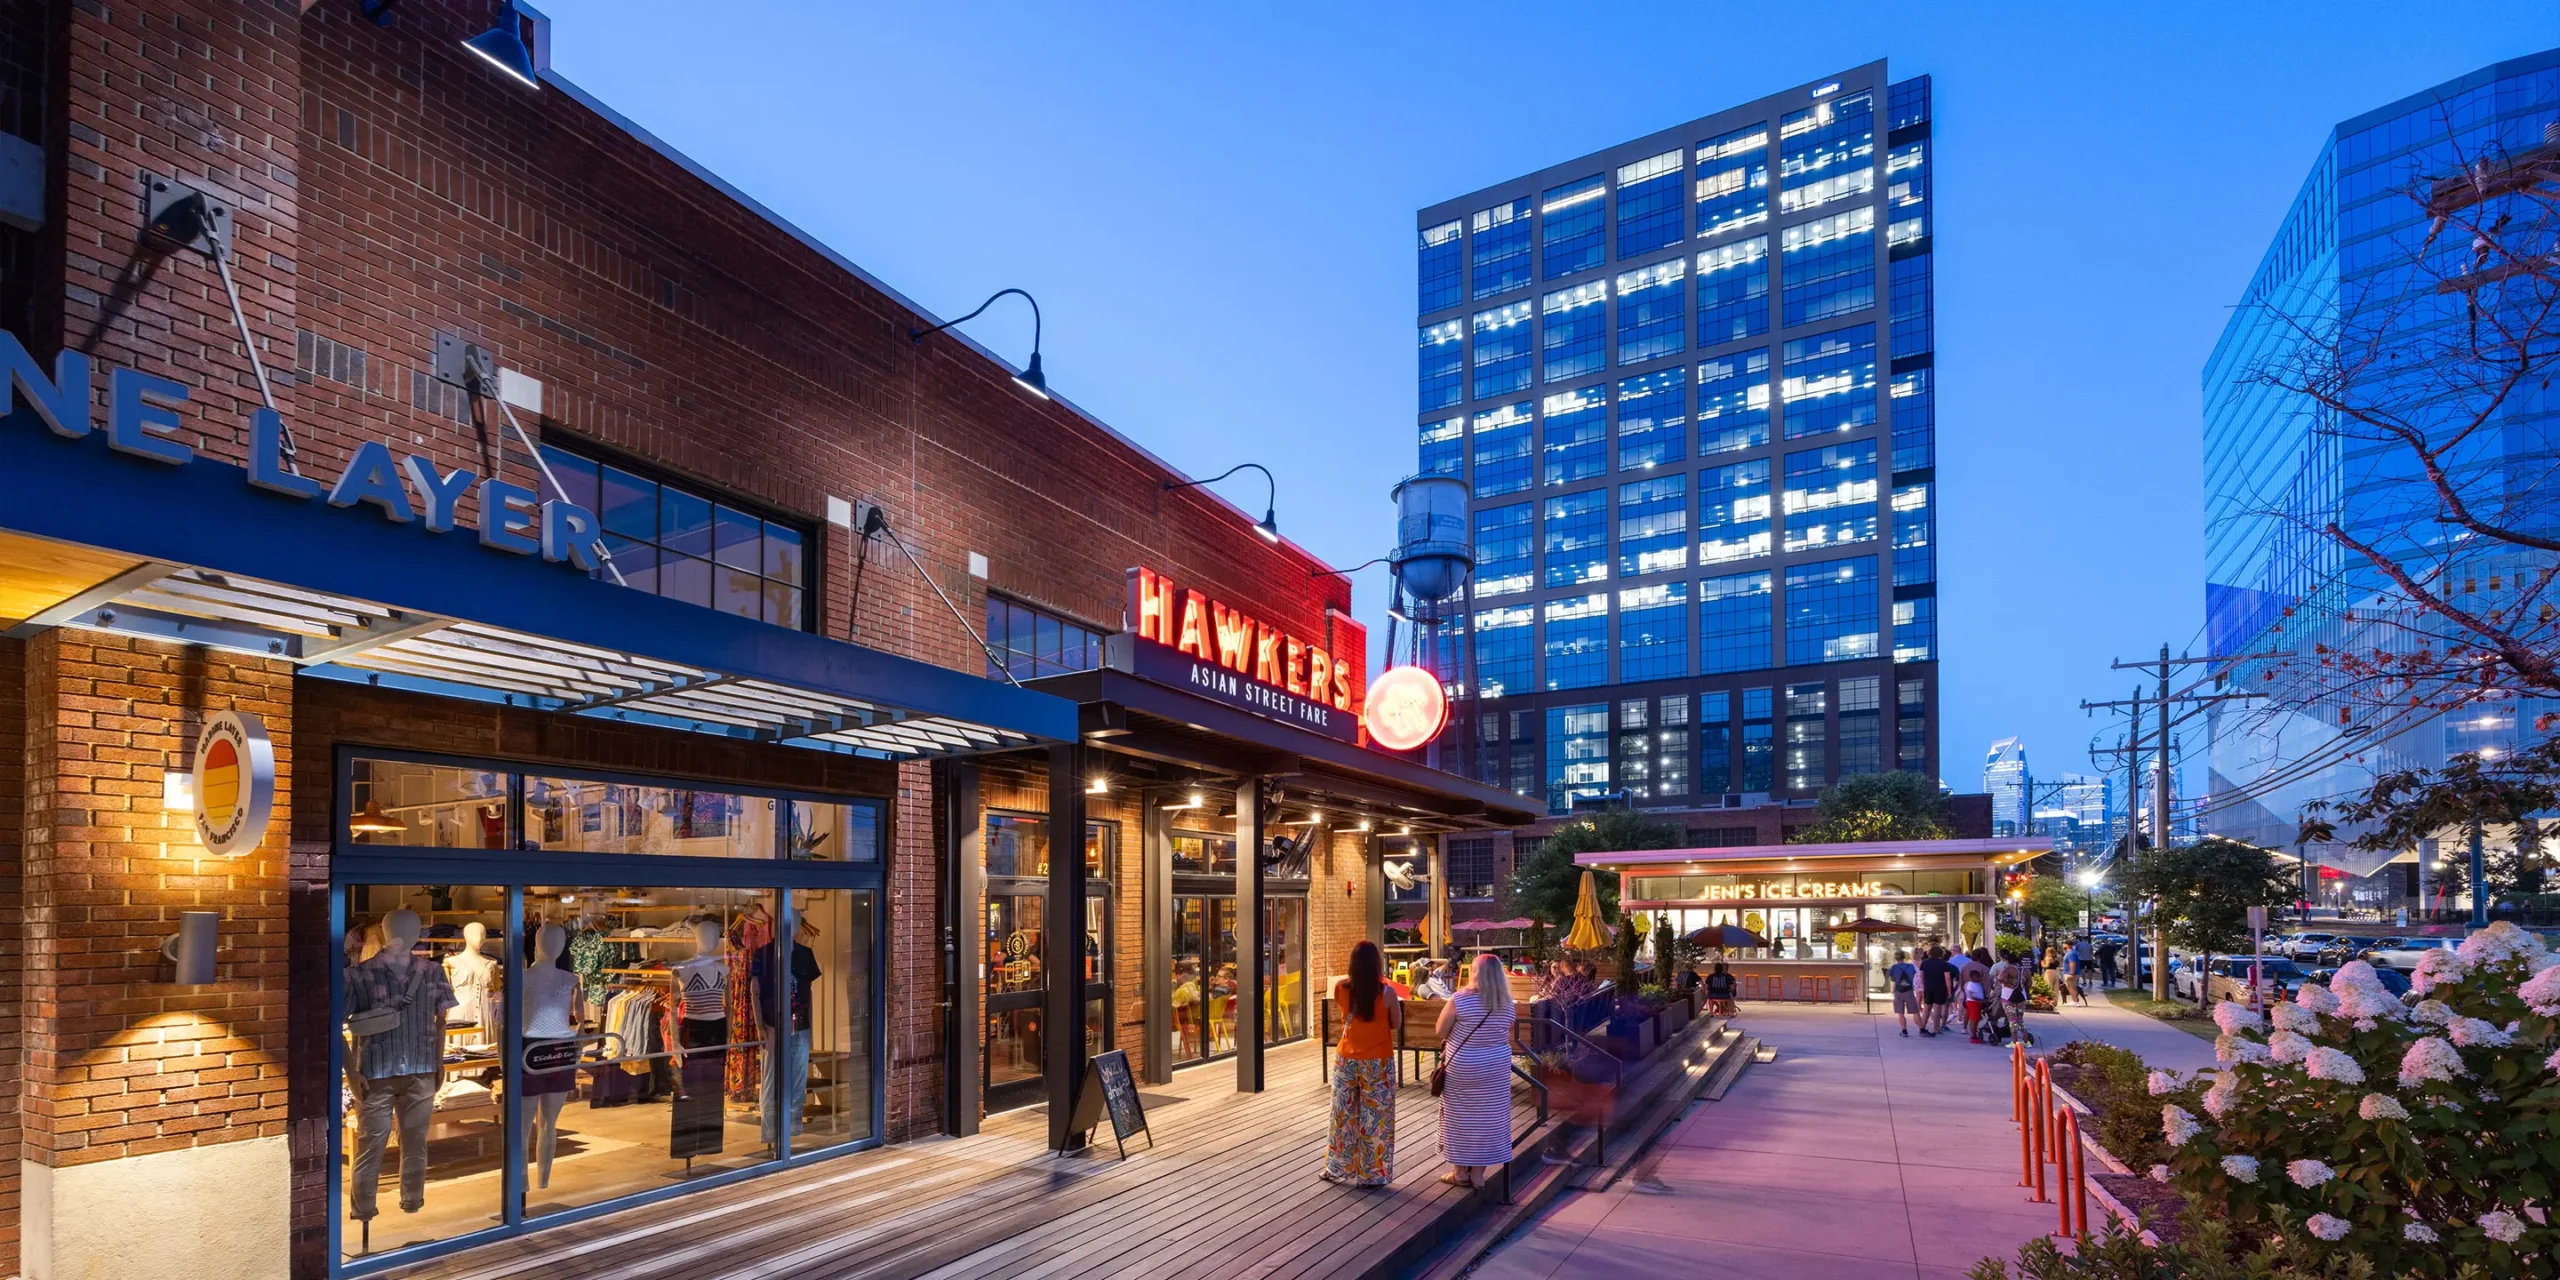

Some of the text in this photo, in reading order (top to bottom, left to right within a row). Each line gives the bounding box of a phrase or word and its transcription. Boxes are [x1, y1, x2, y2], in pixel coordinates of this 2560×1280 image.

[248, 407, 602, 571] LAYER
[1137, 566, 1351, 711] HAWKERS
[1191, 663, 1328, 727] ASIAN STREET FARE
[200, 720, 243, 754] MARINE LAYER
[209, 807, 244, 845] FRANCISCO
[1700, 882, 1882, 899] JENI'S ICE CREAMS
